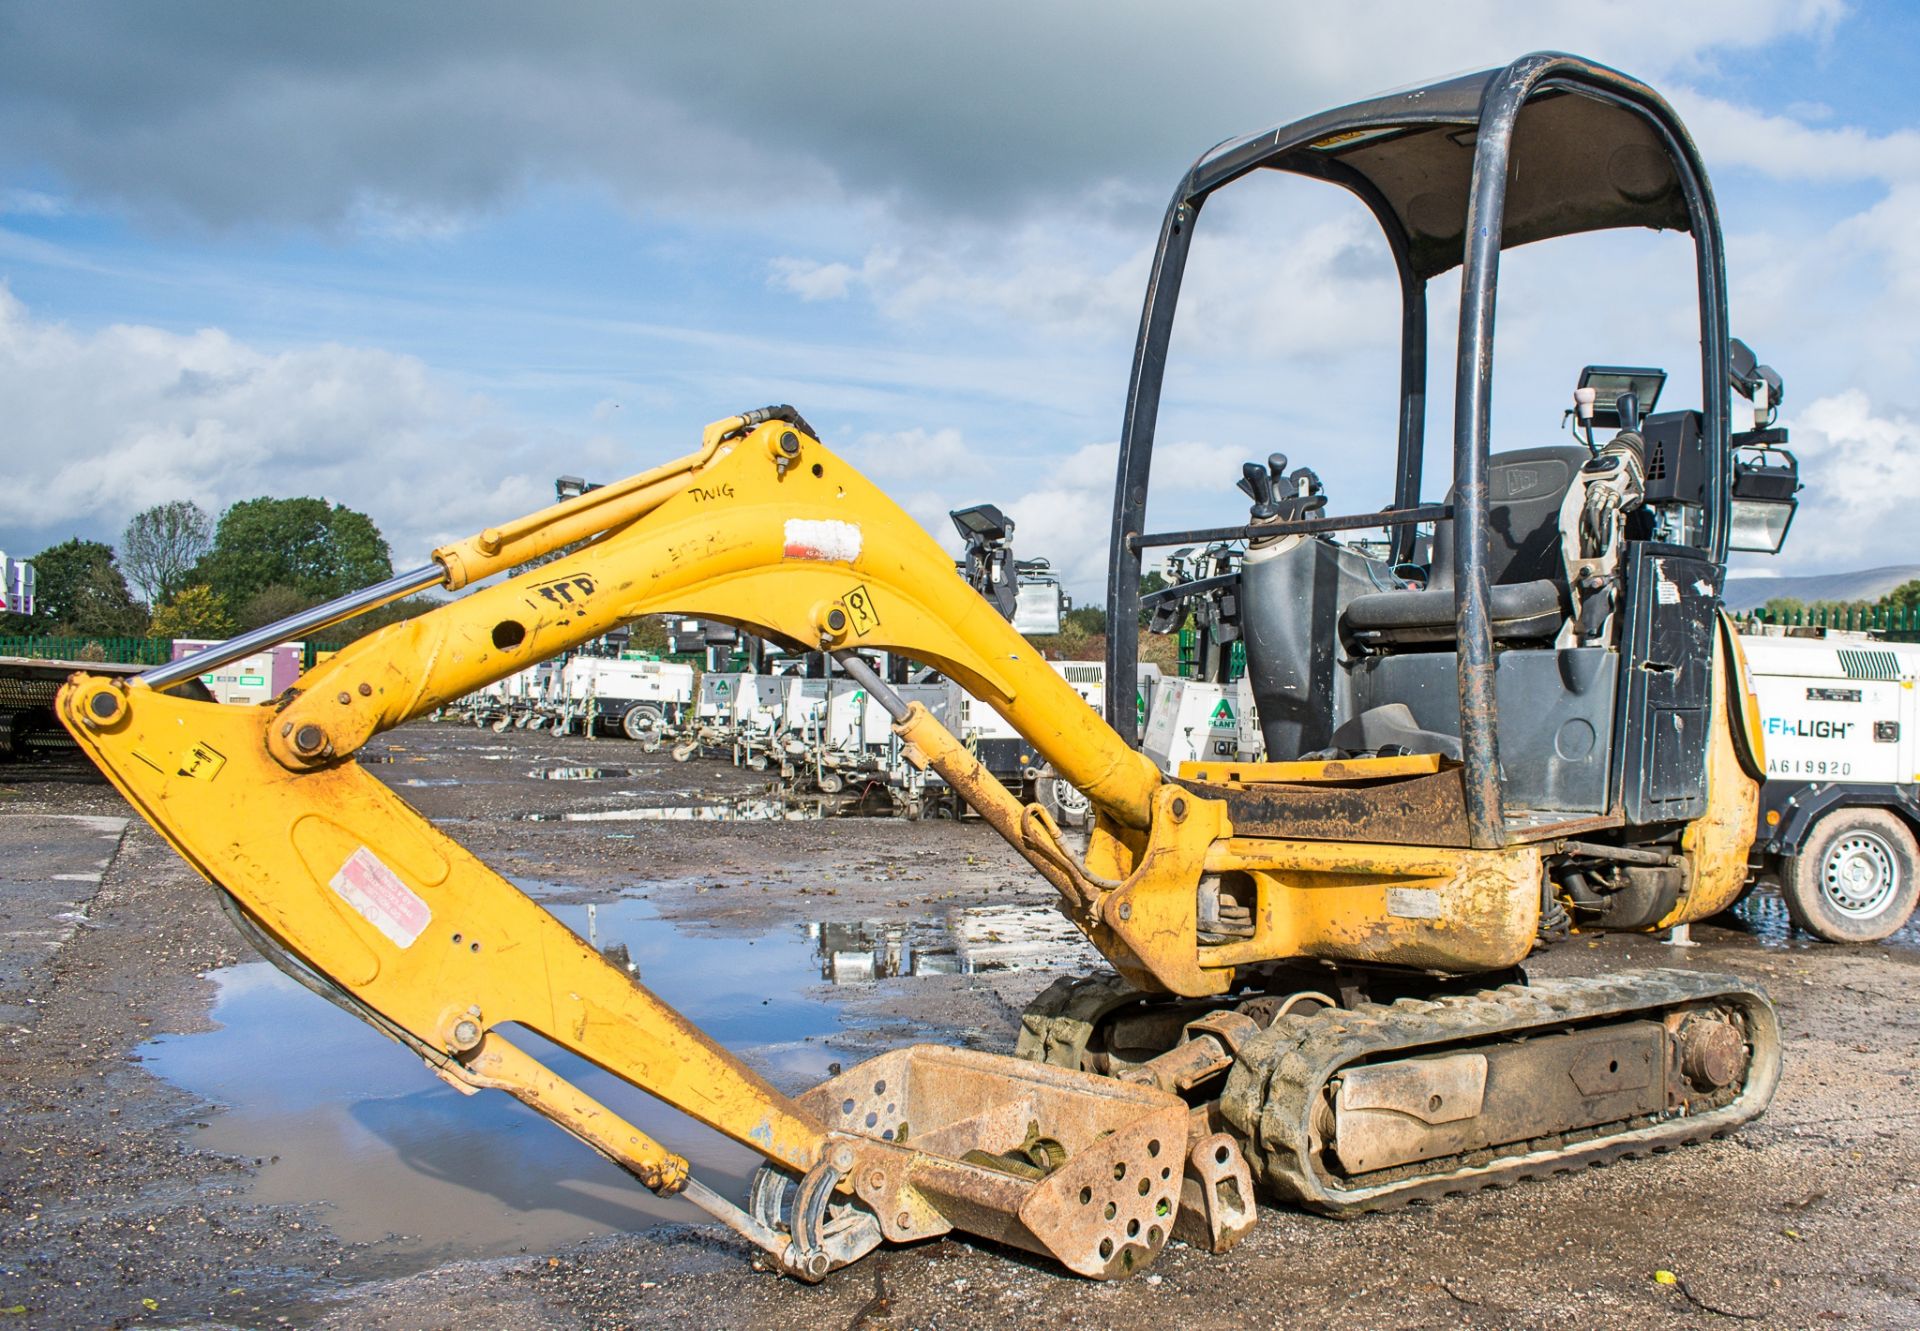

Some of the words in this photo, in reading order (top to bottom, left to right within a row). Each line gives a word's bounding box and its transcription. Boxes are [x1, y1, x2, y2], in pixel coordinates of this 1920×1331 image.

[688, 483, 734, 502] TWIG
[1208, 720, 1236, 728] PLANT
[1769, 759, 1851, 776] A619920
